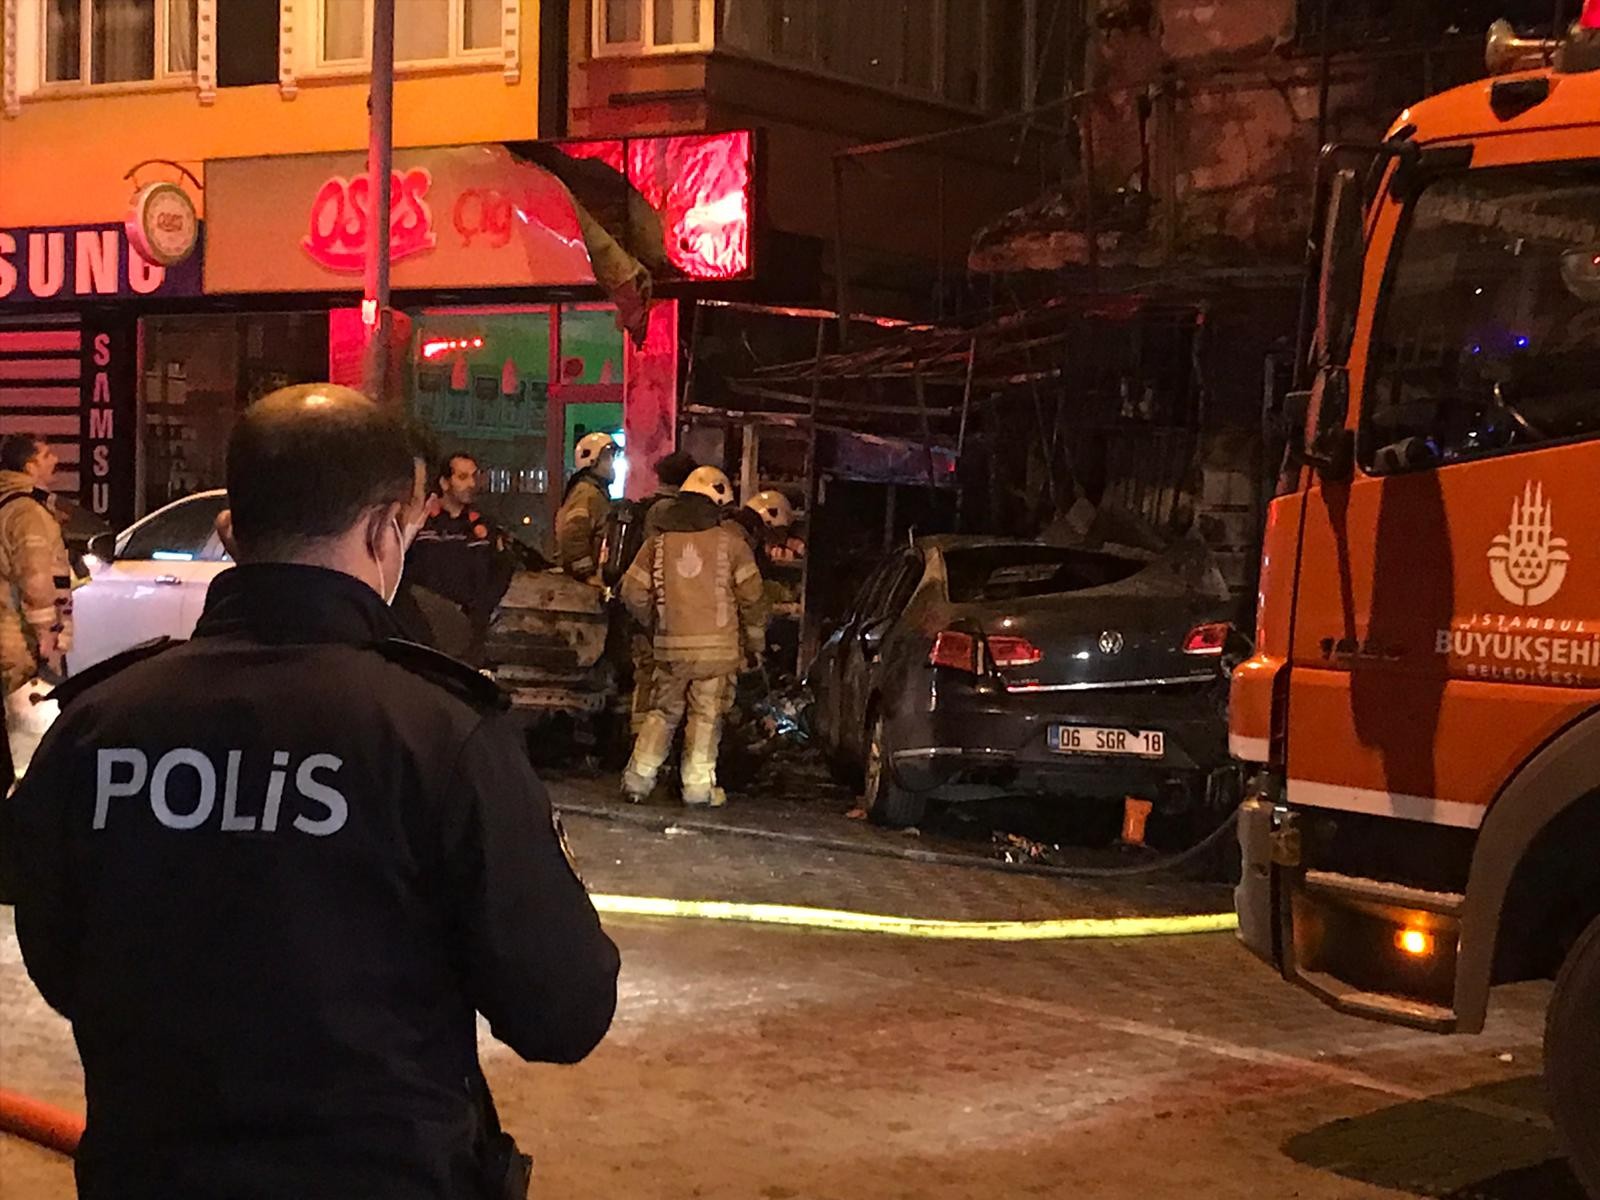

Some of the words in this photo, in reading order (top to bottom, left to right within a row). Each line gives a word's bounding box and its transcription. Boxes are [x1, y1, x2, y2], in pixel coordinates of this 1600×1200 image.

[89, 333, 114, 526] SAMSU
[1061, 728, 1080, 748] 06
[1096, 731, 1126, 750] SGR
[1143, 734, 1161, 752] 18
